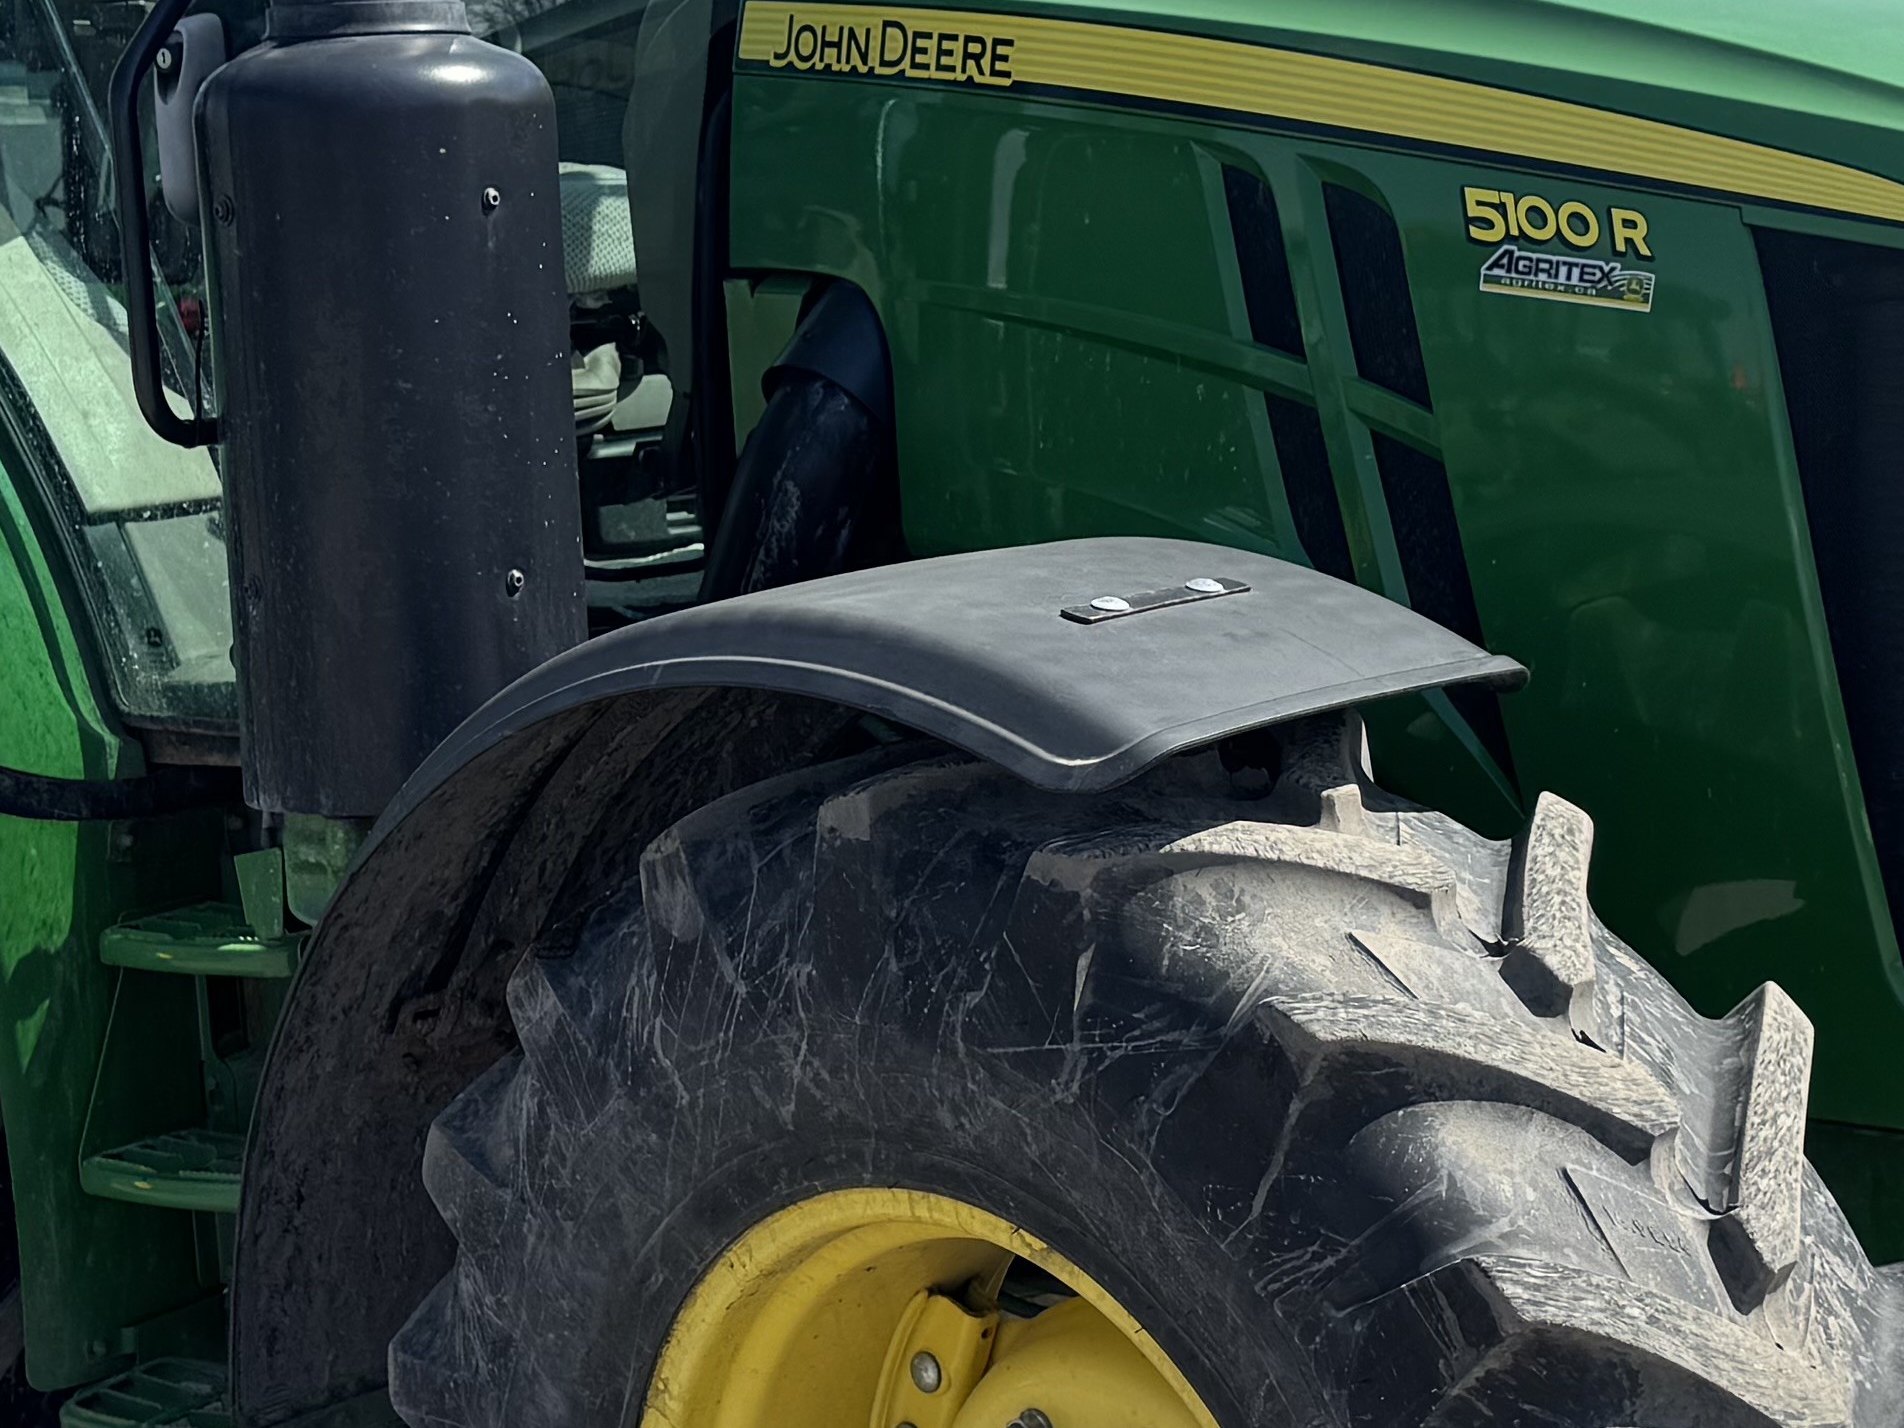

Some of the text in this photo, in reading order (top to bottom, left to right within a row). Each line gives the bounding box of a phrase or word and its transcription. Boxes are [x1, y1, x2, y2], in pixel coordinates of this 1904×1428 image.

[773, 13, 1015, 80] JOHN DEERE
[1463, 186, 1653, 257] 5100 R
[1485, 248, 1619, 287] AGRITEX
[1500, 276, 1597, 296] agritex.ca
